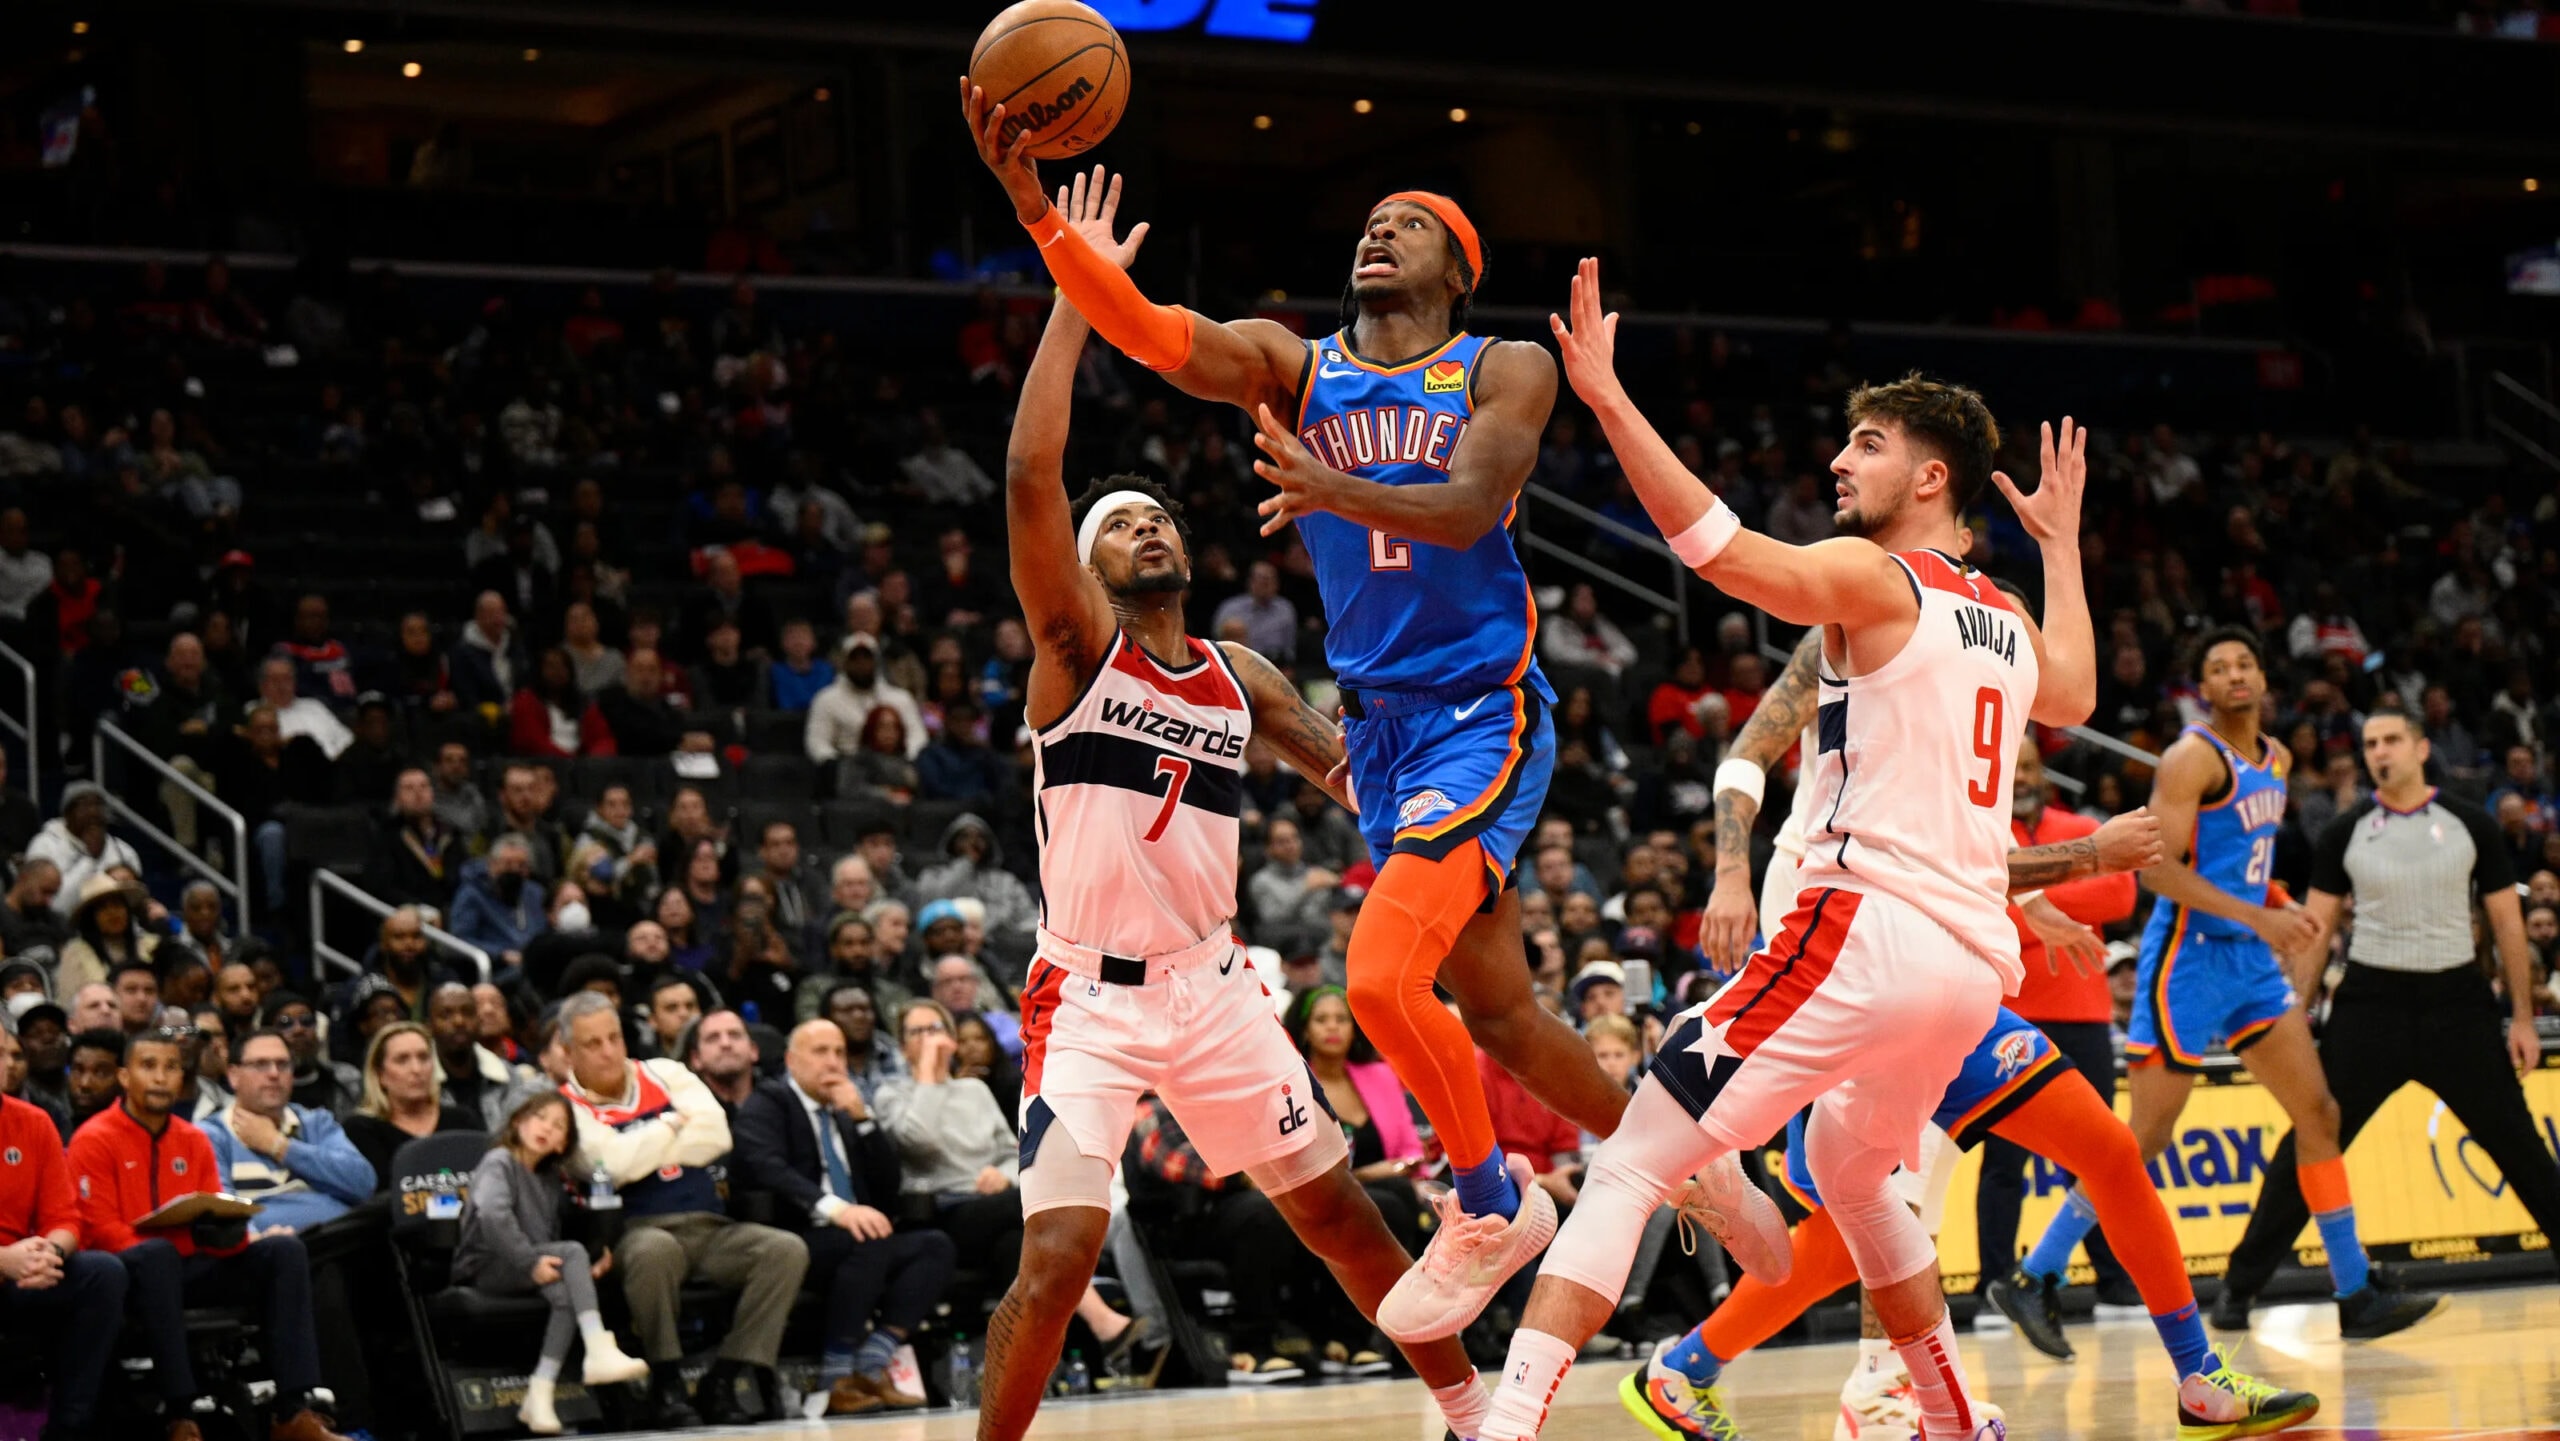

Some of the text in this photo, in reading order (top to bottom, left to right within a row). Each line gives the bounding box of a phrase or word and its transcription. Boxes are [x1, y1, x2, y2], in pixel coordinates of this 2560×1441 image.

[1327, 350, 1342, 363] 6
[1955, 605, 2016, 667] AVDIJA
[1968, 686, 2003, 808] 9
[1142, 754, 1192, 843] 7
[2245, 836, 2274, 884] 21
